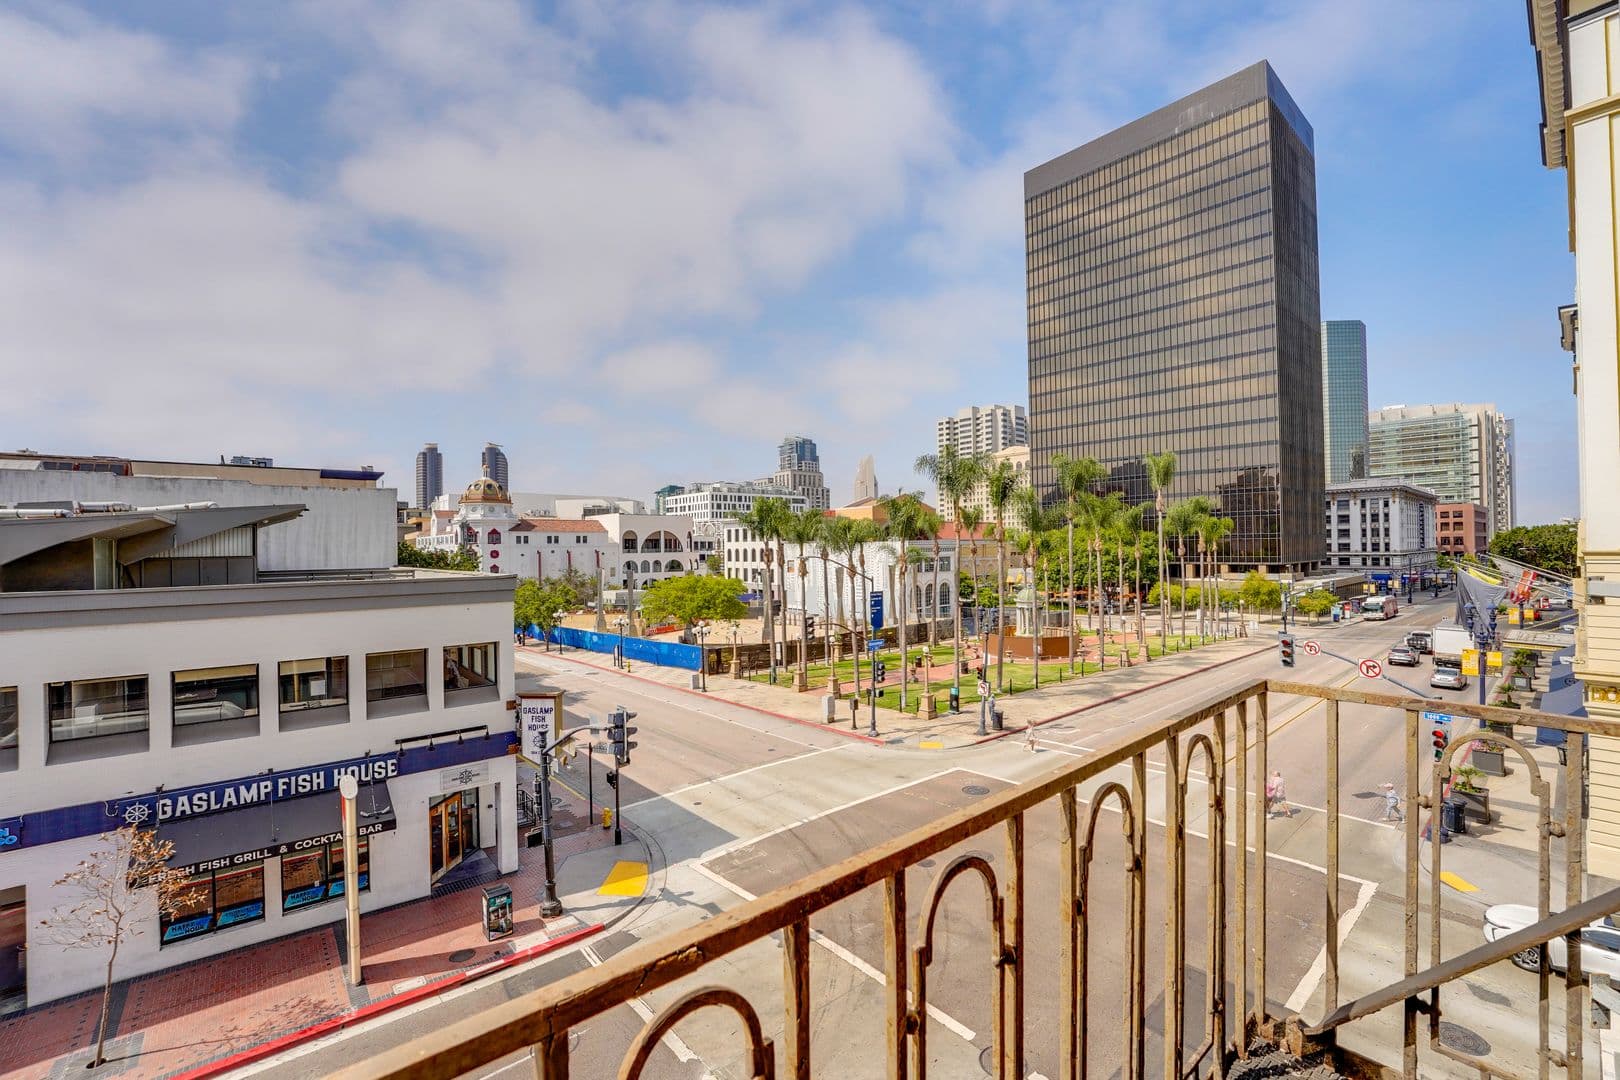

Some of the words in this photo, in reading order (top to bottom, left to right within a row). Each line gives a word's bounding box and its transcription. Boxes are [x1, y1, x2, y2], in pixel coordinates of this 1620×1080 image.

[523, 706, 554, 715] GASLAMP
[531, 715, 546, 723] FISH
[159, 780, 273, 821] GASLAMP
[278, 771, 325, 798] FISH
[199, 857, 230, 873] FISH
[233, 849, 273, 864] GRILL
[280, 845, 288, 854] &
[294, 832, 344, 851] COCKTA
[359, 823, 383, 836] BAR
